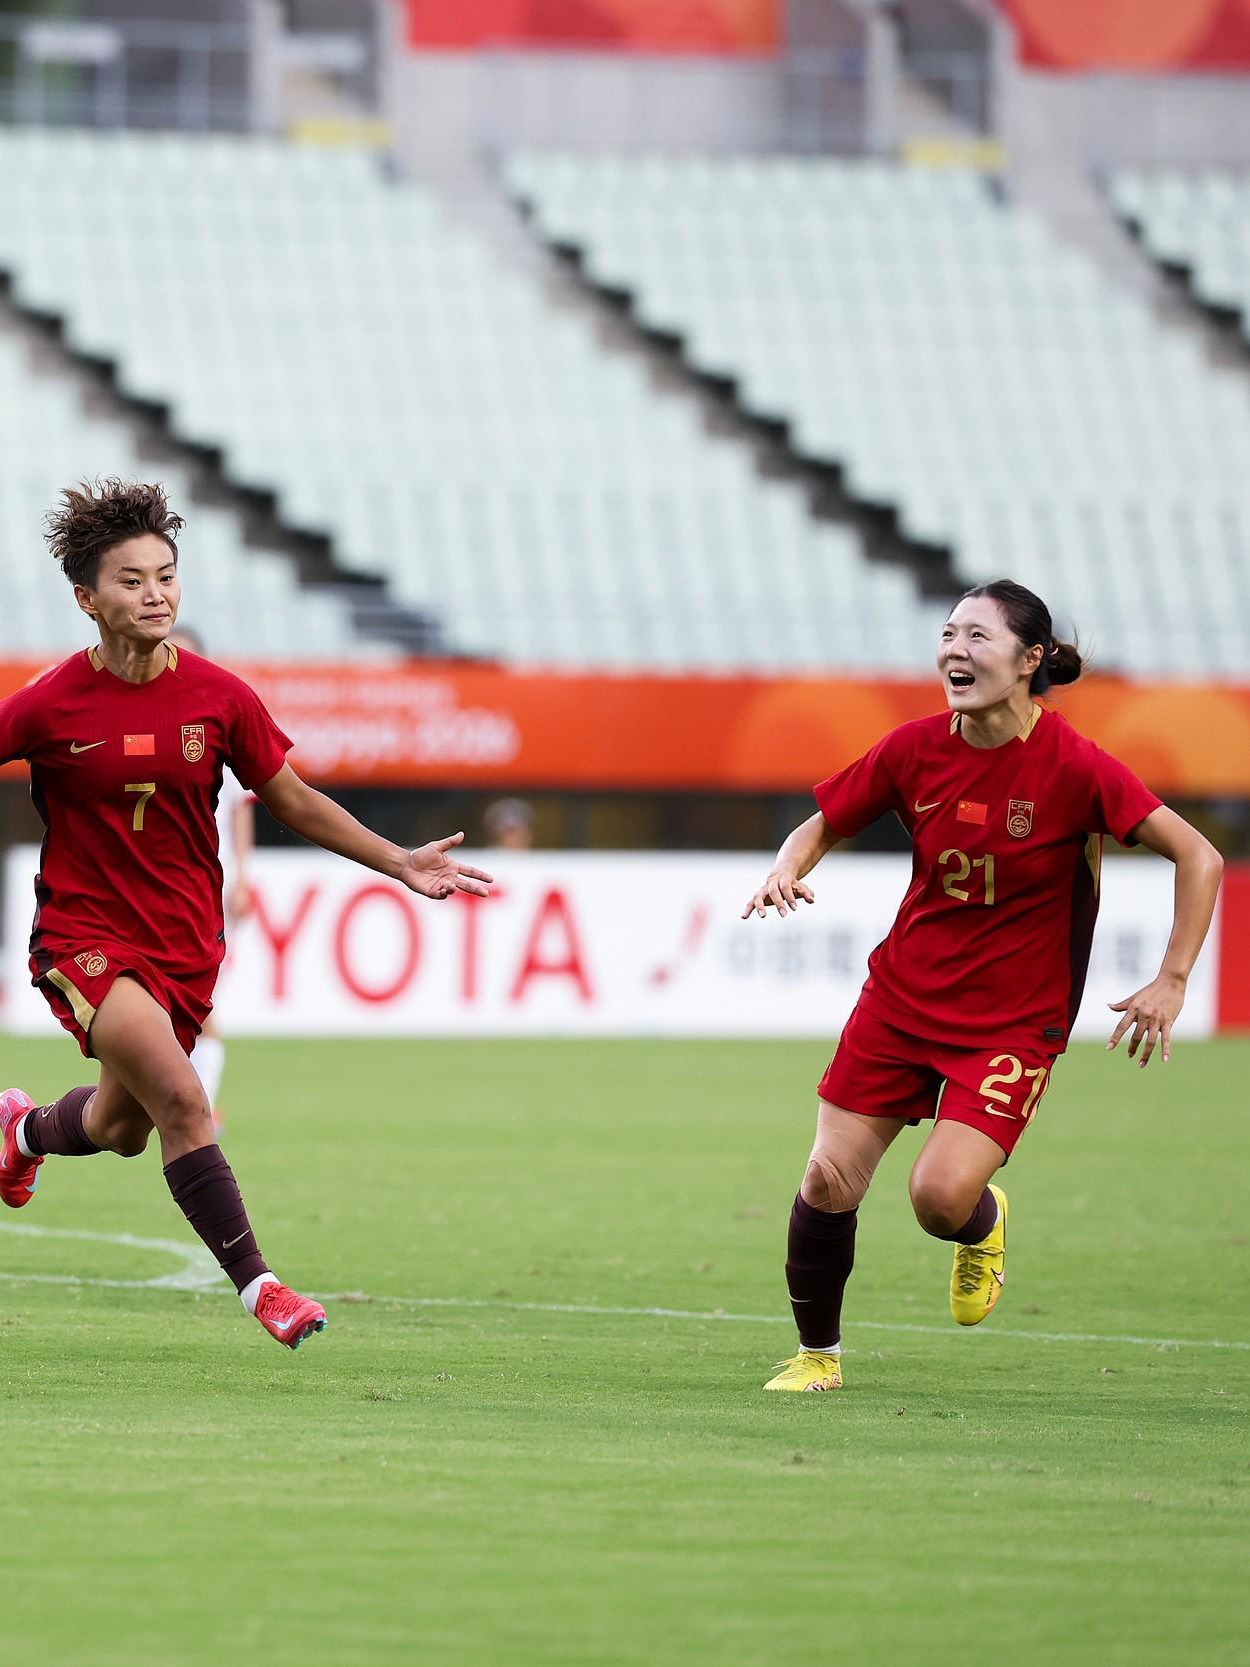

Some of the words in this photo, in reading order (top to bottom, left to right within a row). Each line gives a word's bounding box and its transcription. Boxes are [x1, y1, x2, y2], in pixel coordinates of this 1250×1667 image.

[125, 782, 156, 831] 7
[938, 848, 995, 905] 21
[246, 882, 596, 1006] YOTA
[978, 1054, 1047, 1118] 21
